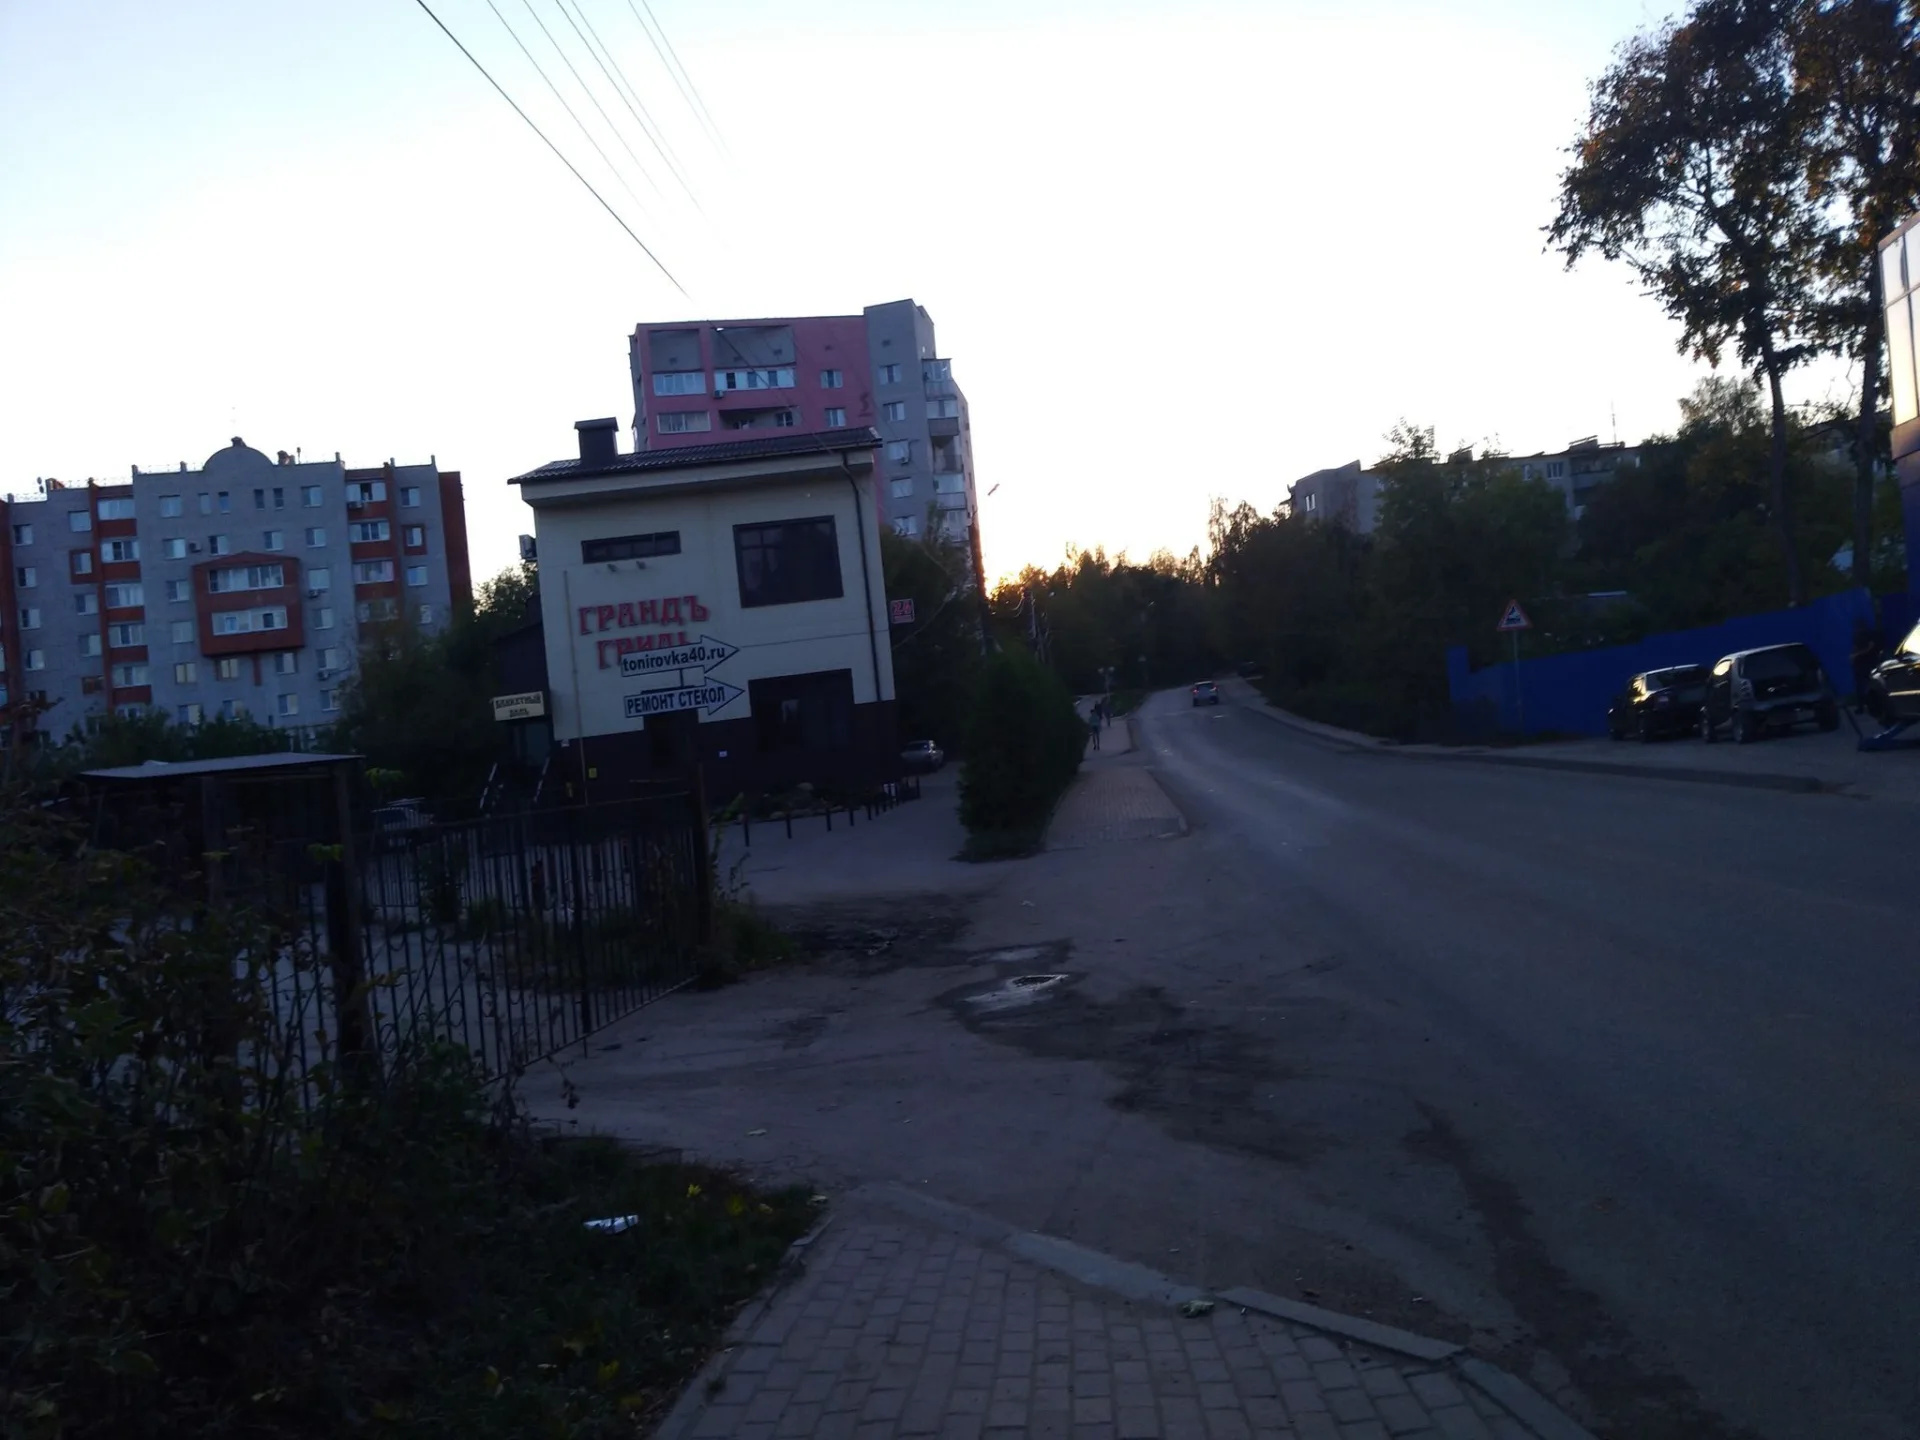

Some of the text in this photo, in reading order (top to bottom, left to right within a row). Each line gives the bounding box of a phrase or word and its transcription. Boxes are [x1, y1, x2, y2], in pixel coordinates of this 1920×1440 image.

[579, 595, 709, 635] ГРАНДЪ
[623, 647, 726, 672] tonirovka40.ru
[627, 686, 726, 715] РЕМОНТ СТЕКОЛ
